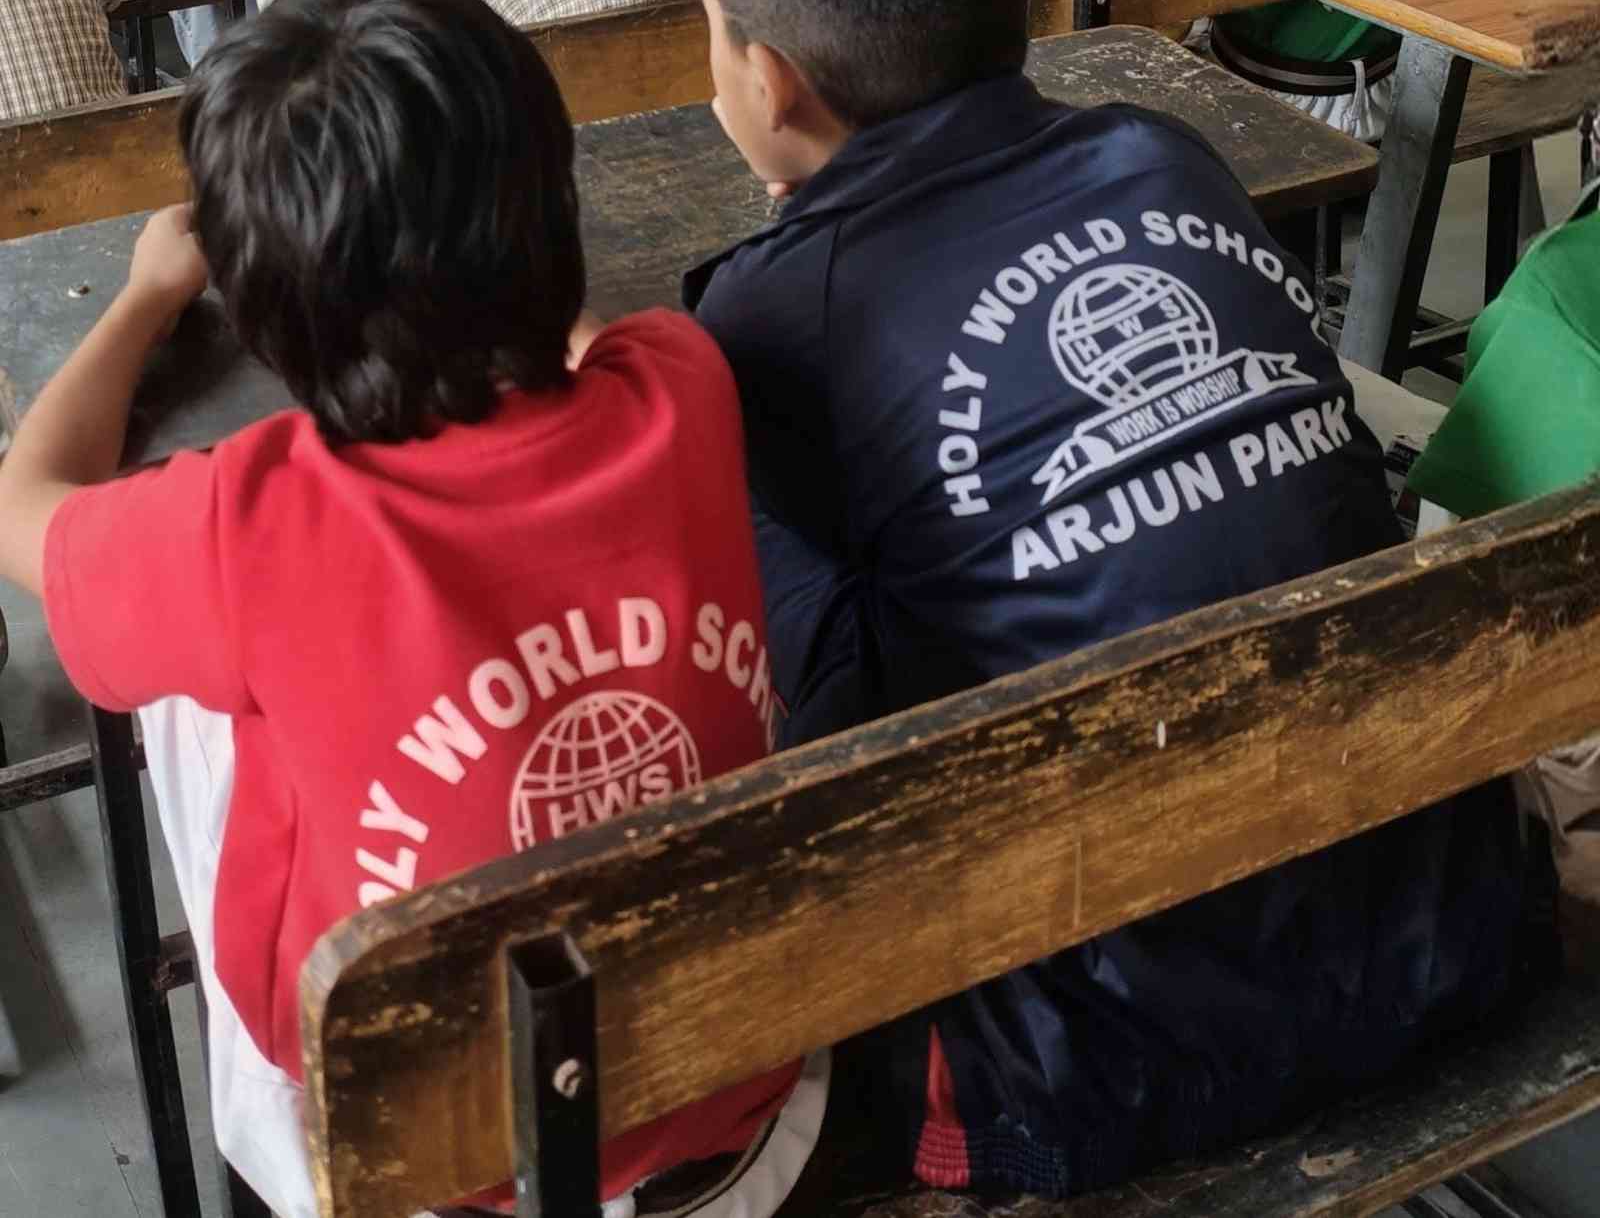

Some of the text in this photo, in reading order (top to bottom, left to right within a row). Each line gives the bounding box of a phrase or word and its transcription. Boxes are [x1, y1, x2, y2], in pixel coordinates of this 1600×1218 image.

[962, 217, 1127, 344] WORLD
[938, 352, 990, 517] HOLY
[1105, 366, 1241, 446] WORK IS WORSHIP
[1011, 395, 1353, 581] ARJUN PARK
[396, 596, 668, 786] WORLD
[548, 762, 674, 840] HWS
